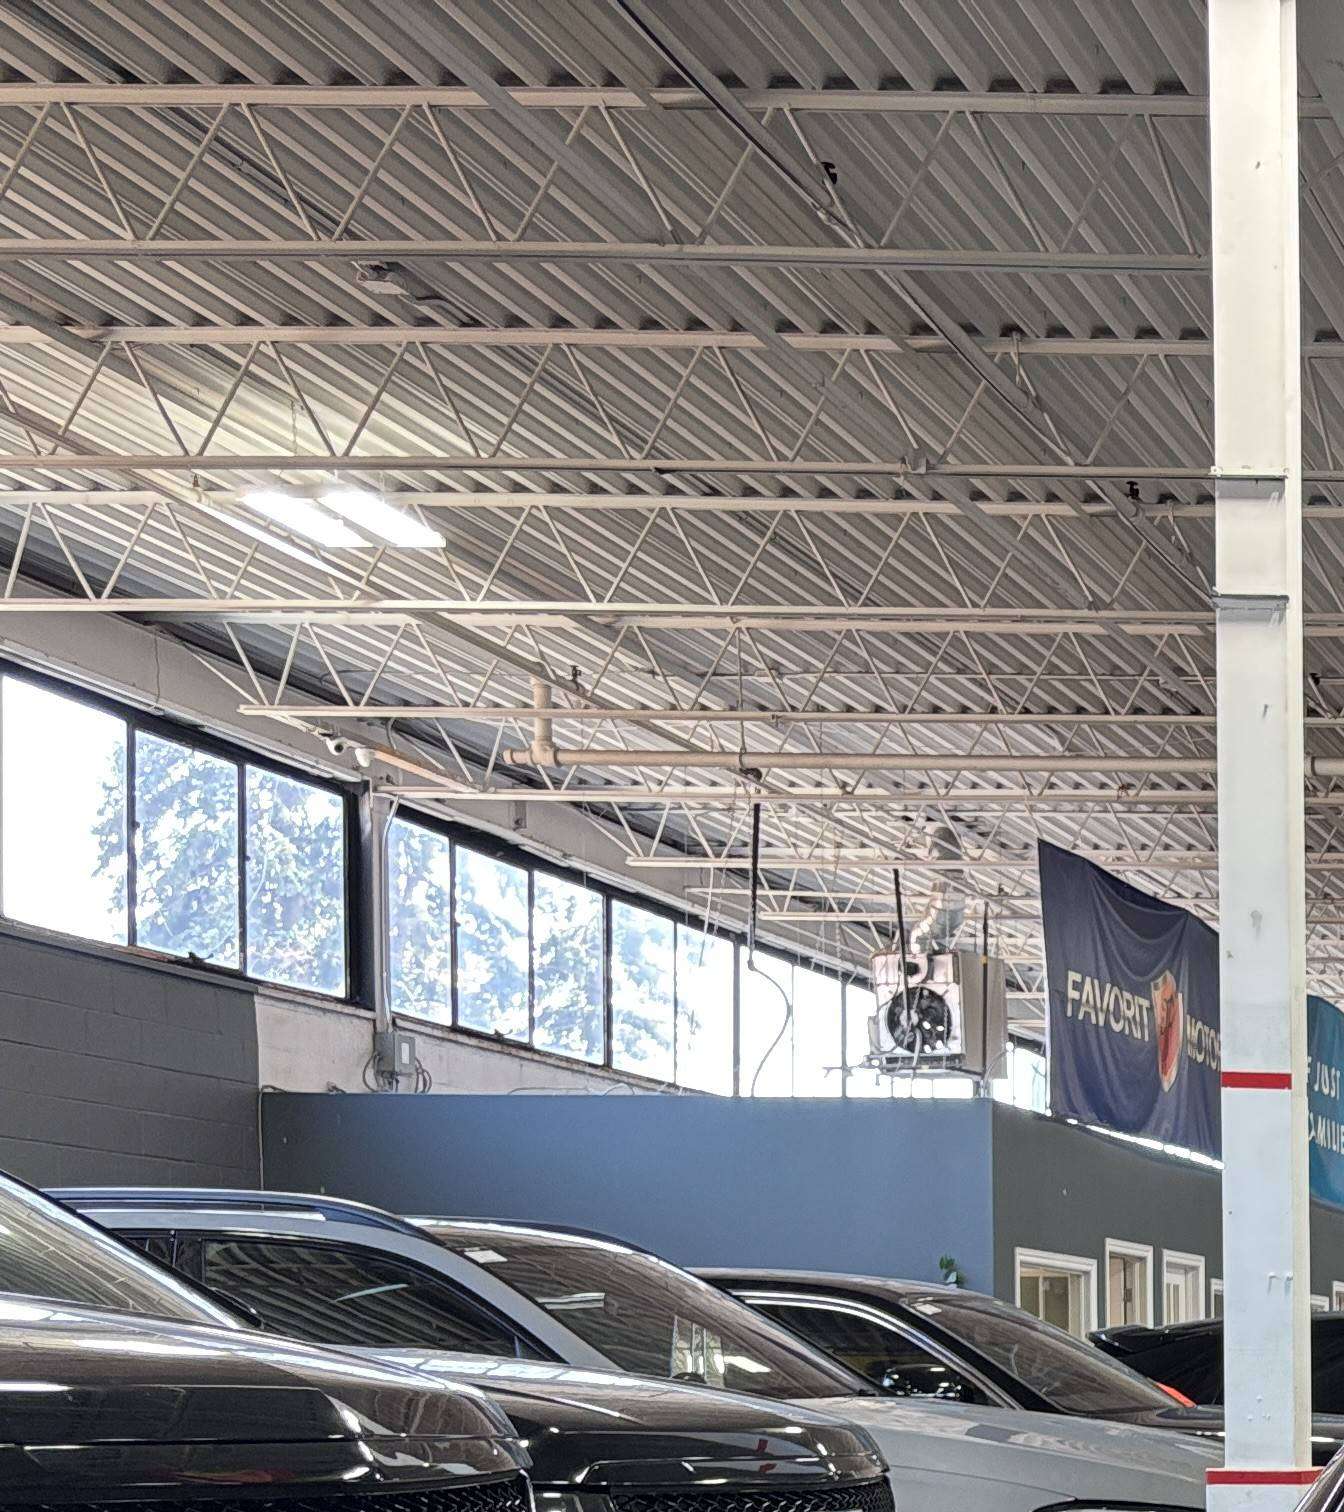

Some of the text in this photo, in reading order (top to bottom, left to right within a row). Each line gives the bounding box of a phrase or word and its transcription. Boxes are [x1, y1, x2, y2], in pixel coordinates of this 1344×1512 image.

[1066, 969, 1220, 1072] FAVORIT MOTO
[1314, 1061, 1341, 1101] JUST
